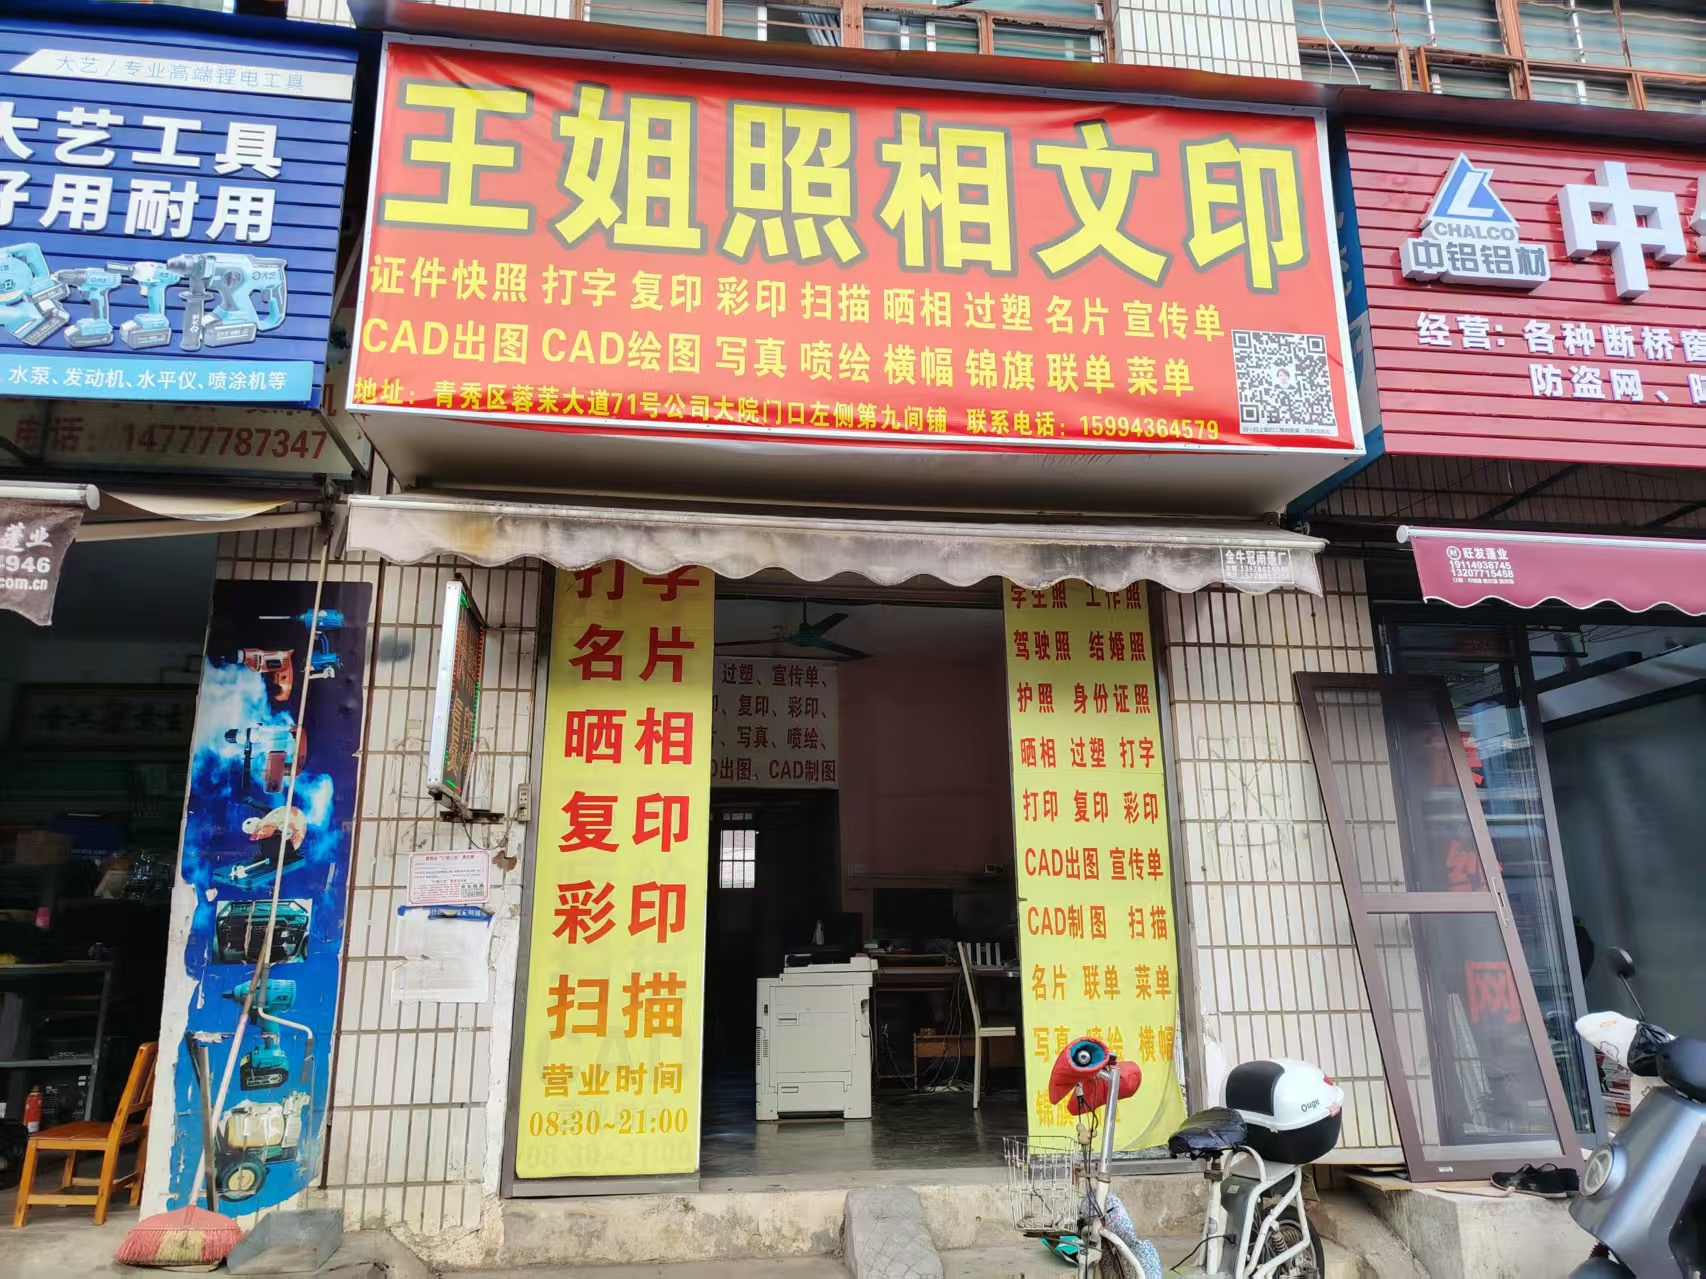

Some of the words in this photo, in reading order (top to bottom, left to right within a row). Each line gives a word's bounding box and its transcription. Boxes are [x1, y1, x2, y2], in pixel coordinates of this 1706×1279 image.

[382, 82, 1309, 293] 王姐照相文印
[1434, 221, 1515, 241] CHALCO
[1412, 240, 1547, 277] 中铝铝材
[370, 255, 527, 302] 证件快照
[542, 264, 617, 307] 打字
[630, 271, 702, 313] 复印
[718, 276, 786, 318] 彩印
[801, 281, 870, 323] 扫描
[883, 288, 951, 327] 晒相
[965, 291, 1033, 331] 过塑
[1047, 295, 1109, 336] 名片
[1123, 300, 1225, 342] 宣传单
[362, 317, 529, 364] CAD出图
[542, 328, 701, 373] CAD绘图
[715, 336, 787, 379] 写真
[800, 341, 871, 383] 喷绘
[883, 343, 953, 387] 横幅
[965, 348, 1035, 390] 锦旗
[1046, 353, 1115, 394] 联单
[1127, 356, 1194, 397] 菜单
[568, 622, 696, 684] 名片
[1013, 629, 1072, 661] 驾驶照
[1088, 630, 1147, 662] 结婚照
[1016, 681, 1055, 714] 护照
[1073, 681, 1152, 715] 身份证照
[564, 706, 696, 767] 晒相
[1020, 735, 1057, 769] 晒相
[1069, 735, 1107, 769] 过塑
[1119, 736, 1156, 769] 打字
[557, 790, 691, 854] 复印
[1022, 788, 1060, 823] 打印
[1073, 789, 1110, 825] 复印
[1123, 790, 1160, 826] 彩印
[1024, 846, 1101, 882] CAD出图
[1109, 846, 1164, 882] 宣传单
[552, 879, 687, 945] 彩印
[1027, 905, 1107, 939] CAD制图
[1127, 905, 1168, 939] 扫描
[1031, 963, 1068, 1001] 名片
[1082, 964, 1121, 1001] 联单
[1134, 964, 1172, 1001] 菜单
[547, 971, 687, 1038] 扫描
[1138, 1026, 1174, 1062] 横幅
[541, 1062, 684, 1097] 营业时间
[529, 1107, 689, 1136] 08:30~21:00
